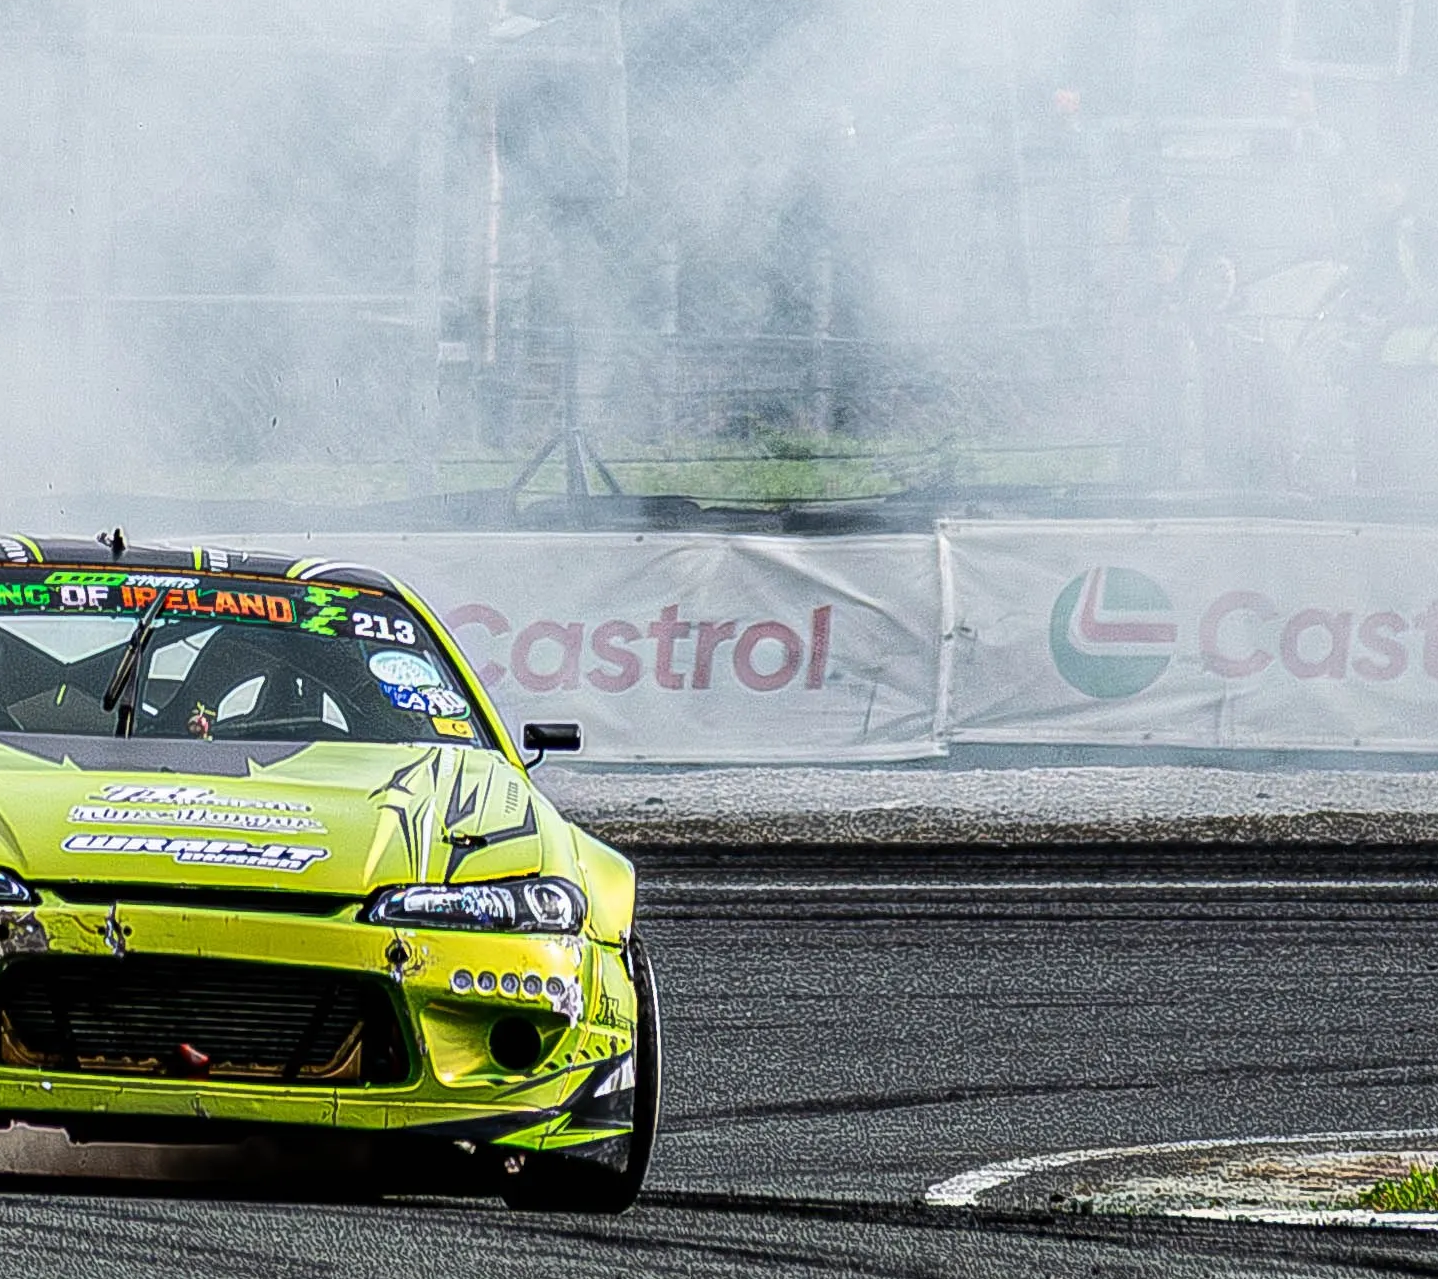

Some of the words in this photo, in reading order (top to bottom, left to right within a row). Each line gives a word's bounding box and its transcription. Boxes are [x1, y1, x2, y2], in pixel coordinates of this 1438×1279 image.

[60, 584, 109, 608] OF
[120, 585, 294, 623] IRELAND
[352, 612, 416, 645] 213
